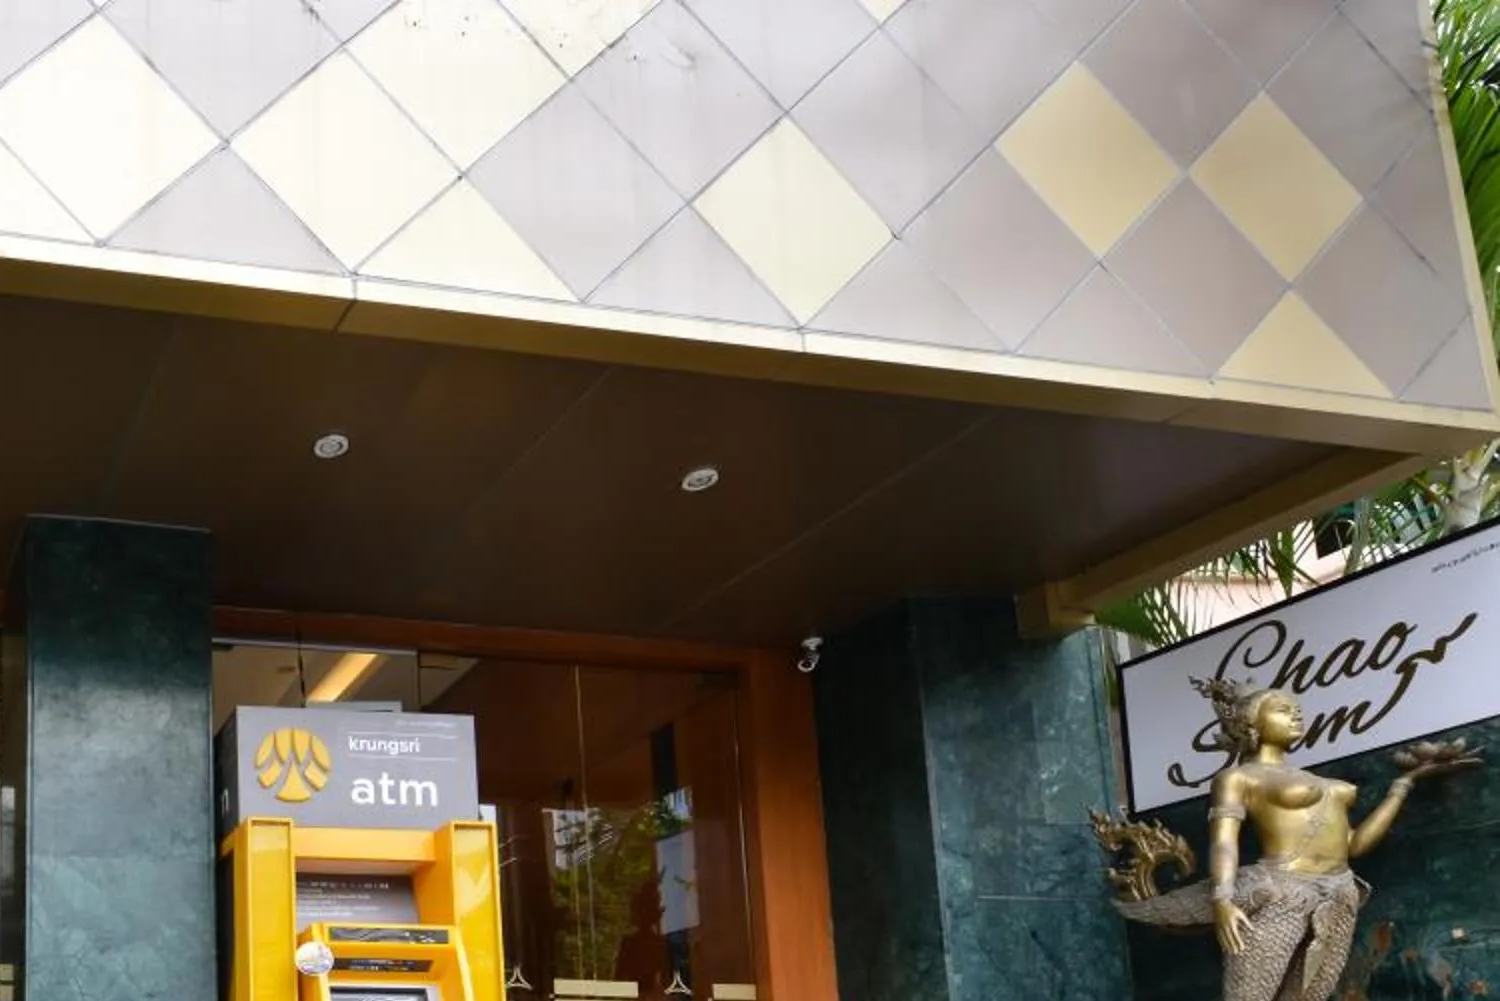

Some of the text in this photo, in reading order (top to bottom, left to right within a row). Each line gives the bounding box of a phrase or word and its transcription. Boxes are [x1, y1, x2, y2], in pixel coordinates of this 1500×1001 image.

[1215, 620, 1417, 694] Chao
[348, 736, 421, 755] krungsri
[351, 772, 438, 807] atm
